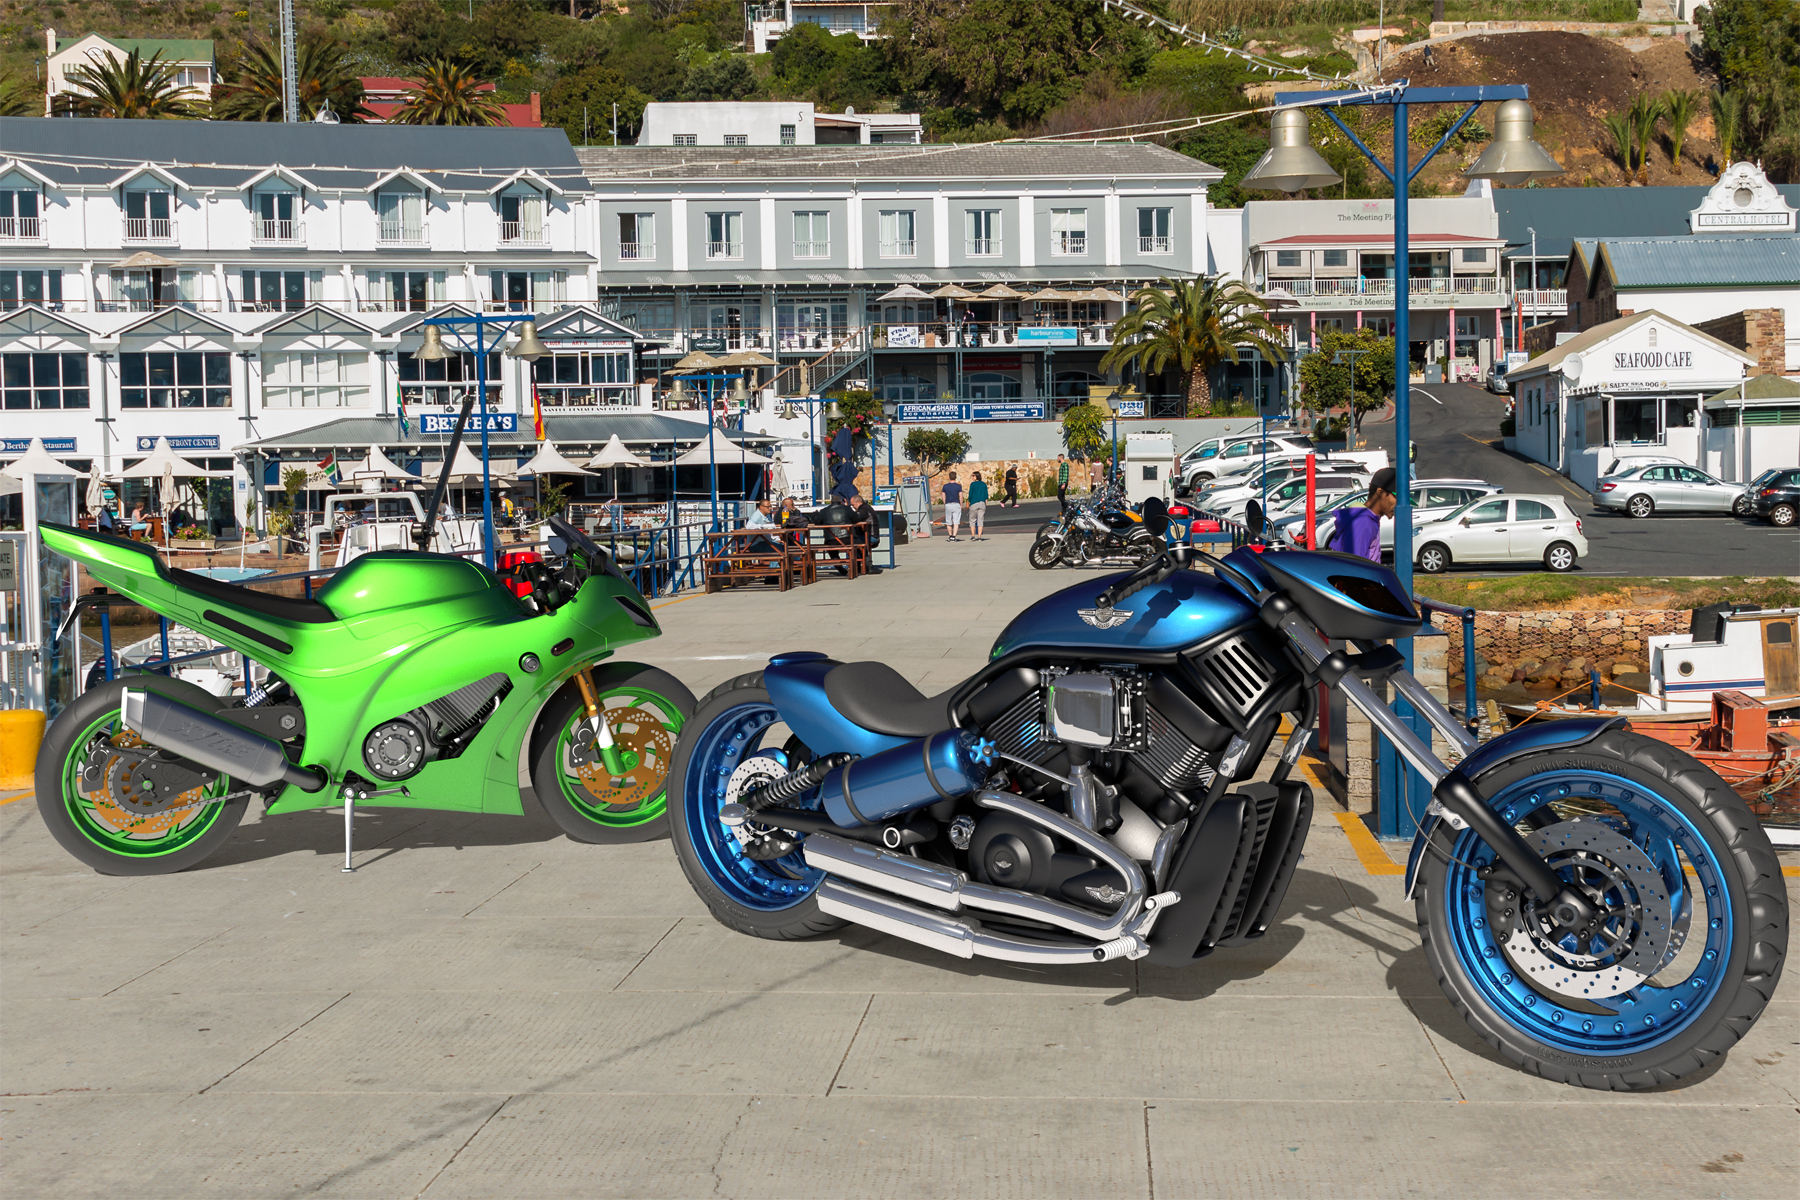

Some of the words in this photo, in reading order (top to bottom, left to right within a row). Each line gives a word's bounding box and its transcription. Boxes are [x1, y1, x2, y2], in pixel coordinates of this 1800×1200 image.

[1353, 214, 1383, 222] Meeting
[1704, 215, 1749, 224] CENTRAL
[1751, 215, 1783, 224] HOTEL
[1365, 298, 1395, 307] Meeting
[1614, 352, 1663, 369] SEAFOOD
[1665, 351, 1692, 368] CAFE
[43, 441, 74, 449] estaurant
[192, 438, 218, 447] CENTRE
[1531, 758, 1628, 778] www.squir.com
